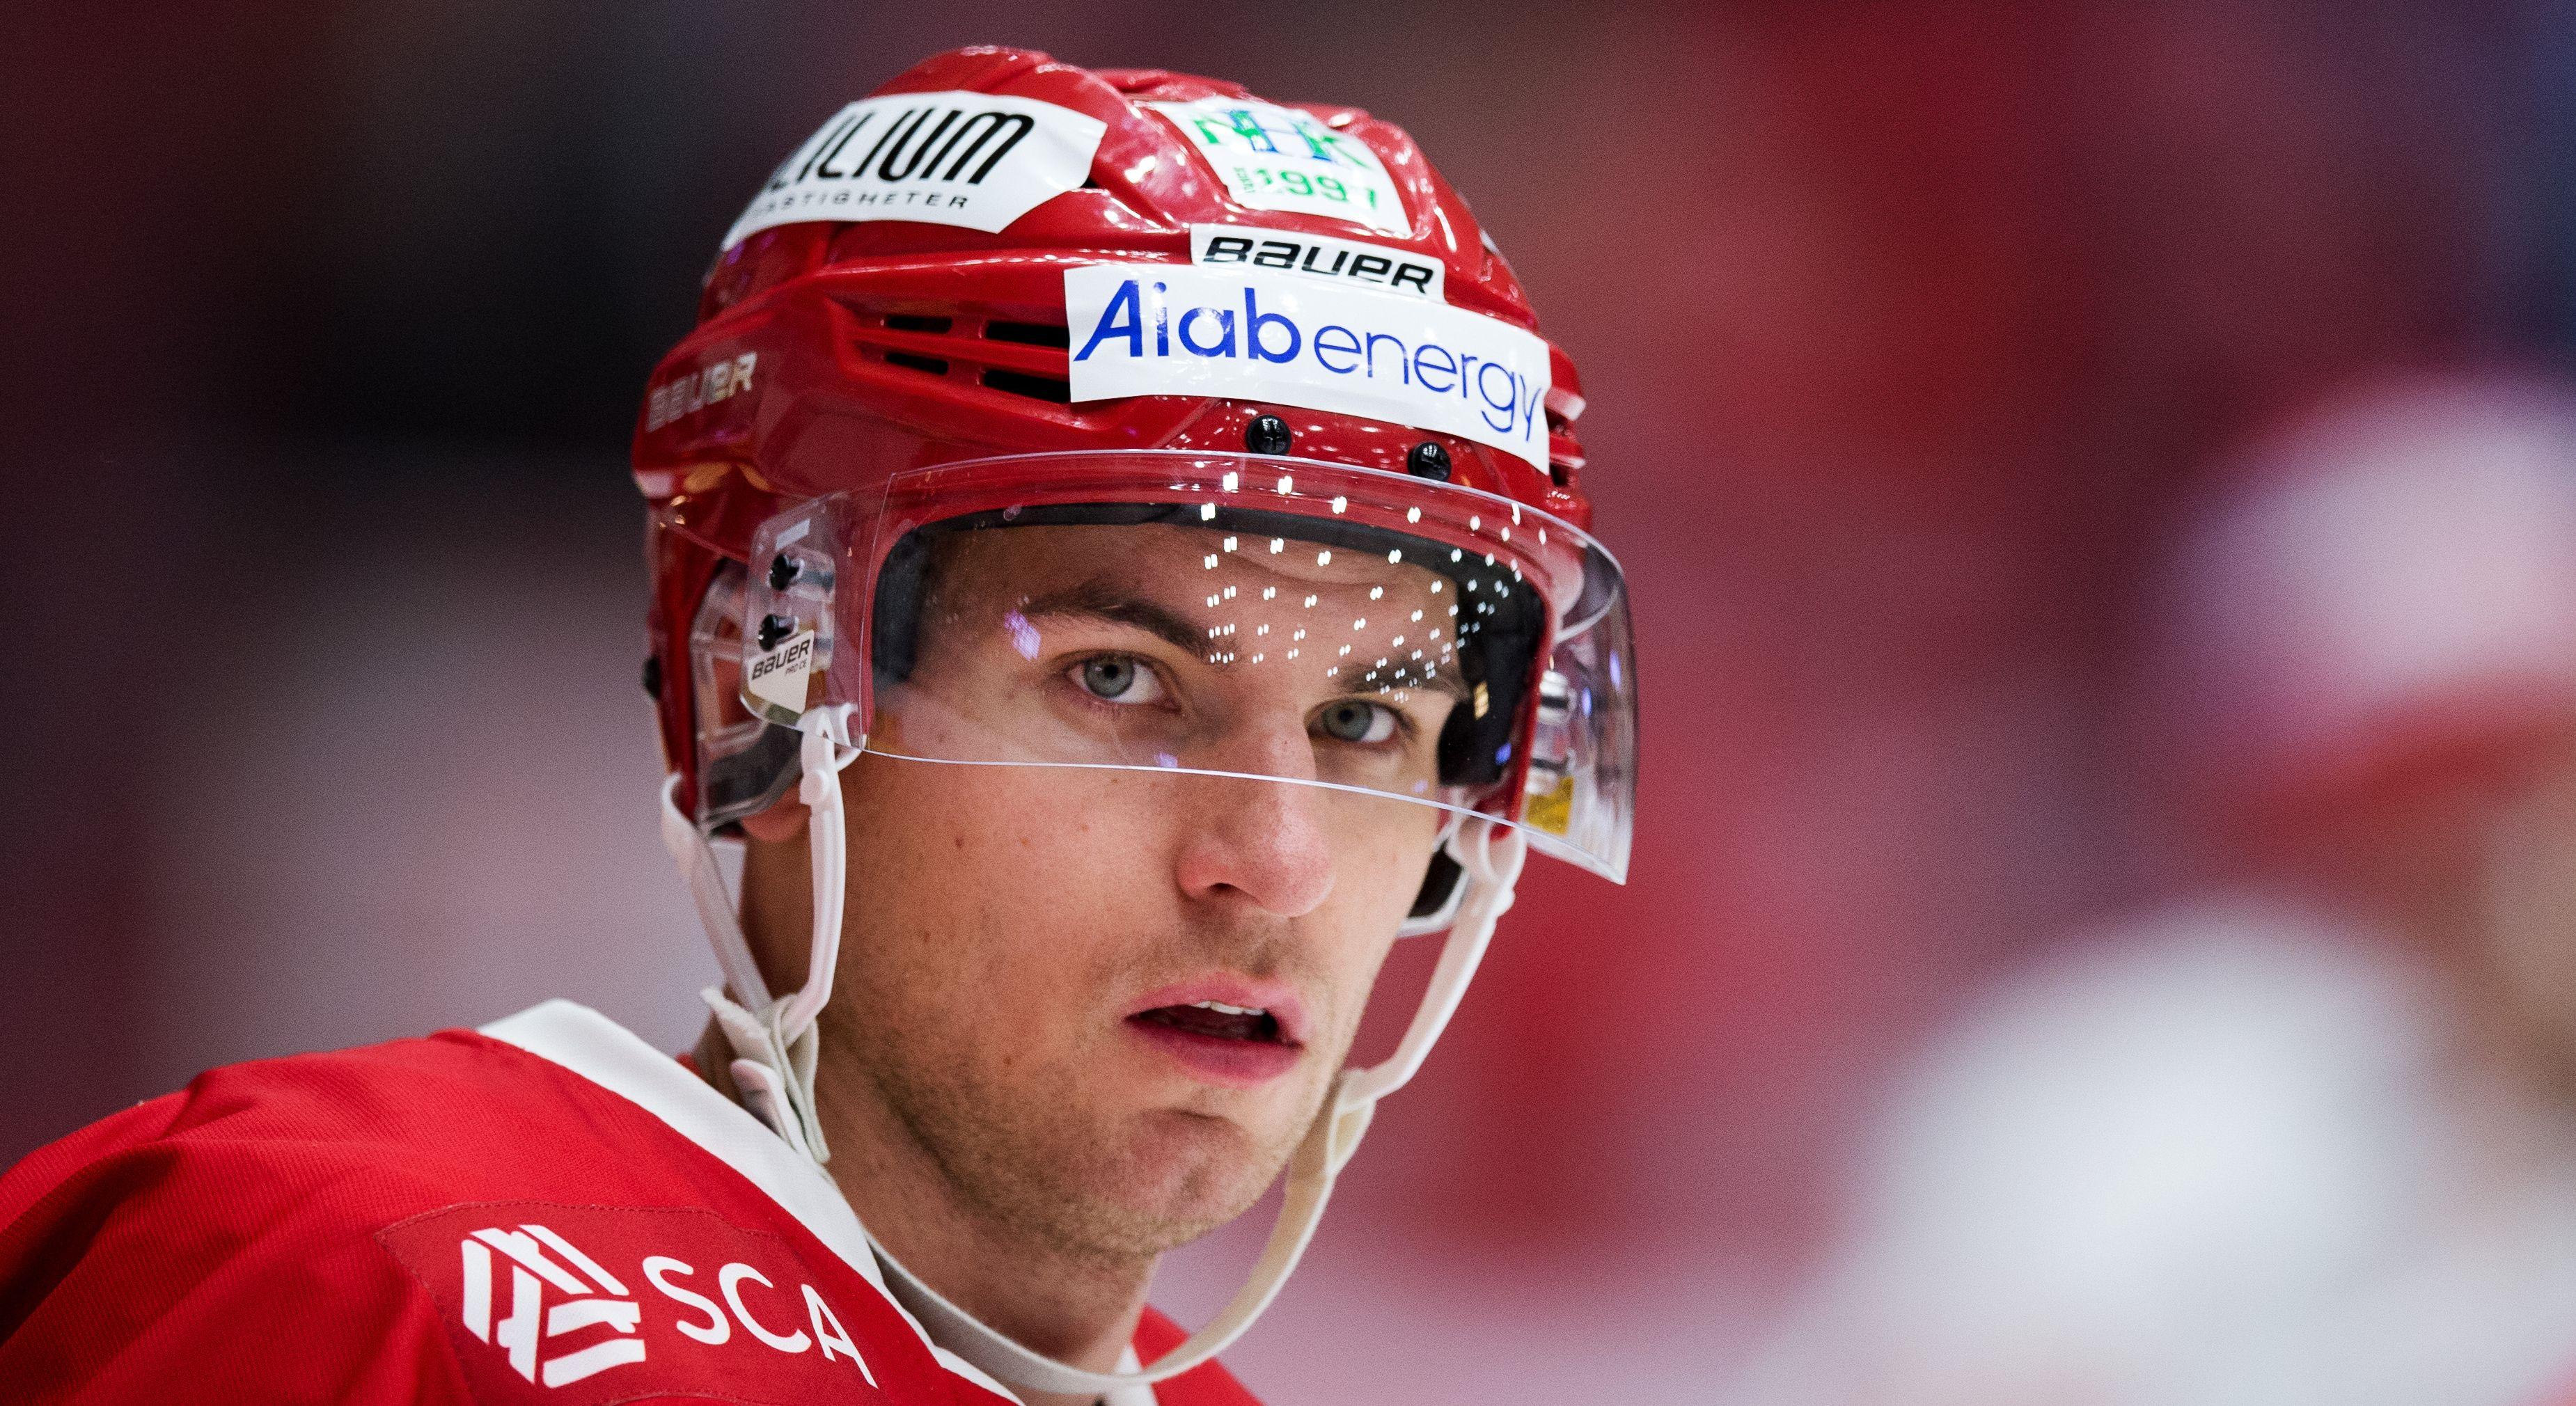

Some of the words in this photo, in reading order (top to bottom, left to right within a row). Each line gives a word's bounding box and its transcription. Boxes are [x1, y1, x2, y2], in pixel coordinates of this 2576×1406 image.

[770, 108, 1035, 191] ILIUM
[757, 189, 969, 212] STIGHETER
[643, 1256, 879, 1389] SCA
